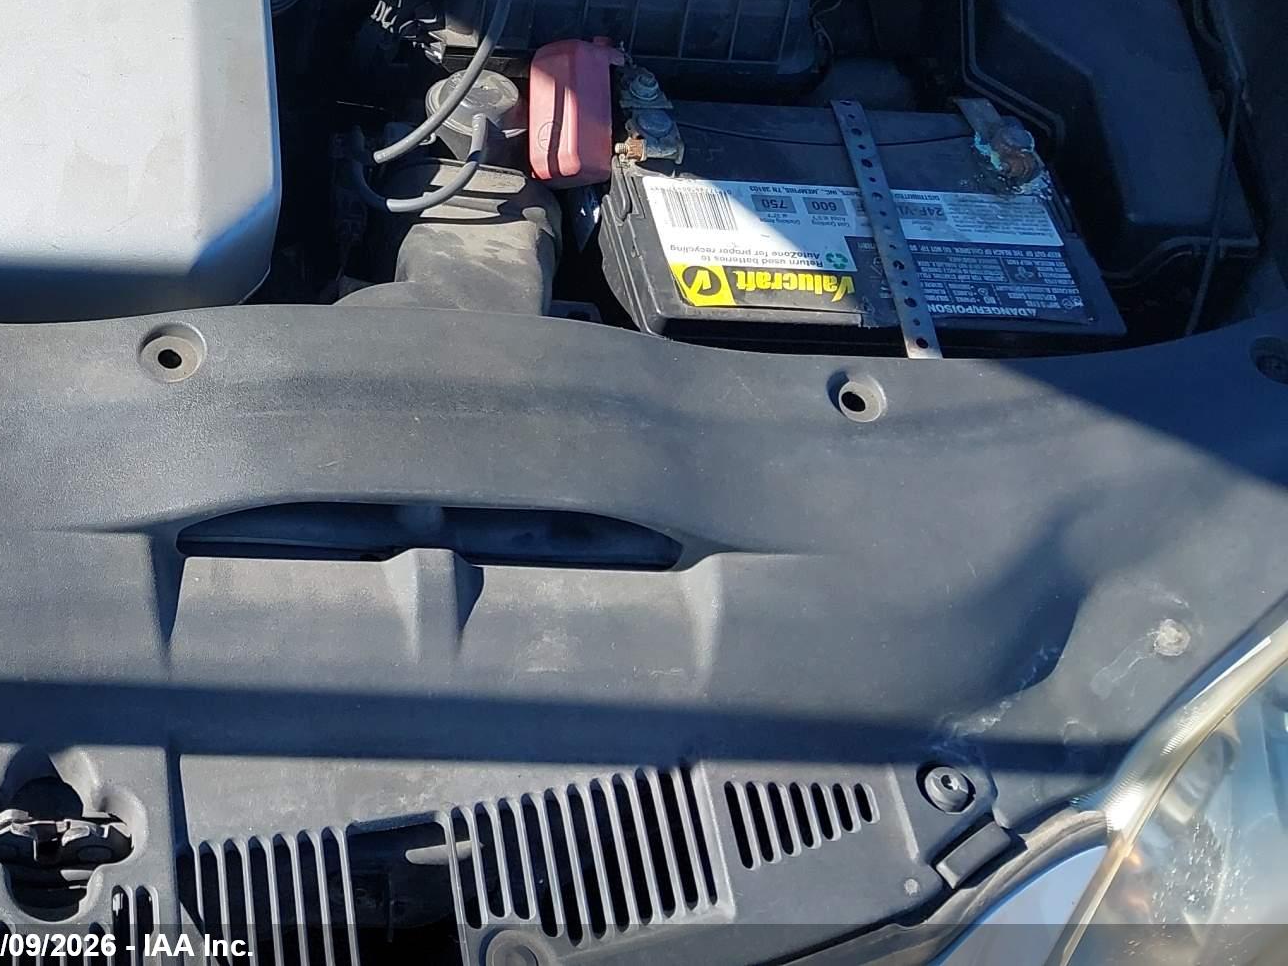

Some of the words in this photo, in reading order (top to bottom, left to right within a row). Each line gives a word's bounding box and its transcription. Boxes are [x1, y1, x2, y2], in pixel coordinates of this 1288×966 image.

[761, 199, 786, 209] 750
[812, 202, 837, 211] 600
[670, 244, 716, 255] recycling
[719, 247, 751, 256] proper
[771, 250, 821, 260] AutoZone
[714, 256, 759, 265] batteries
[761, 257, 786, 265] used
[789, 259, 823, 268] Return
[732, 270, 855, 302] Valucraft
[927, 304, 1028, 316] DANGER/POISON
